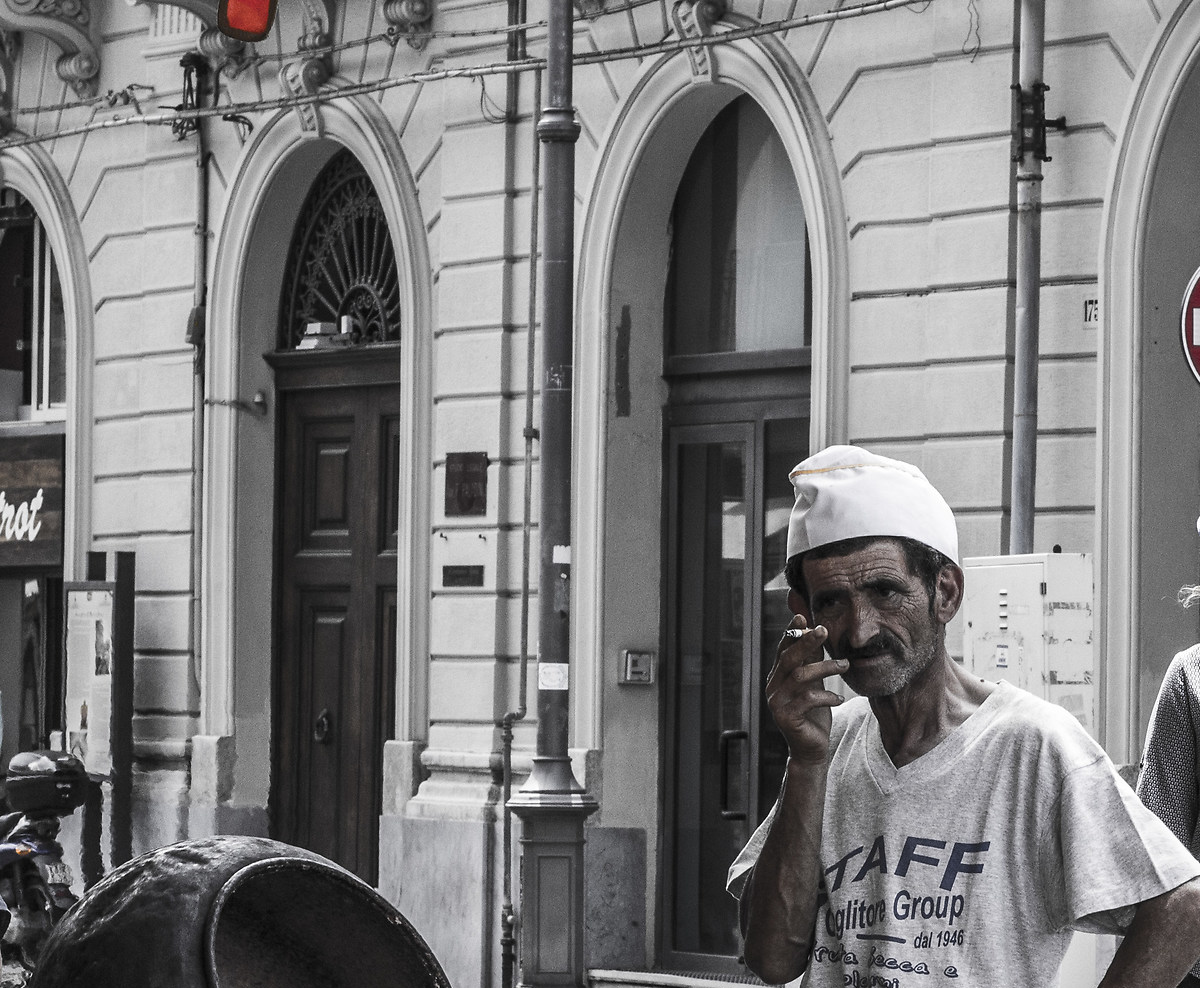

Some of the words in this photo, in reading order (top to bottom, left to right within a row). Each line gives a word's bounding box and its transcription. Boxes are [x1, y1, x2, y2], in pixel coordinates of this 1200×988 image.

[820, 835, 991, 892] TAFF
[824, 899, 886, 940] oglitore
[893, 890, 965, 925] Group
[914, 932, 932, 948] dal
[936, 930, 964, 948] 1946
[943, 965, 959, 978] e
